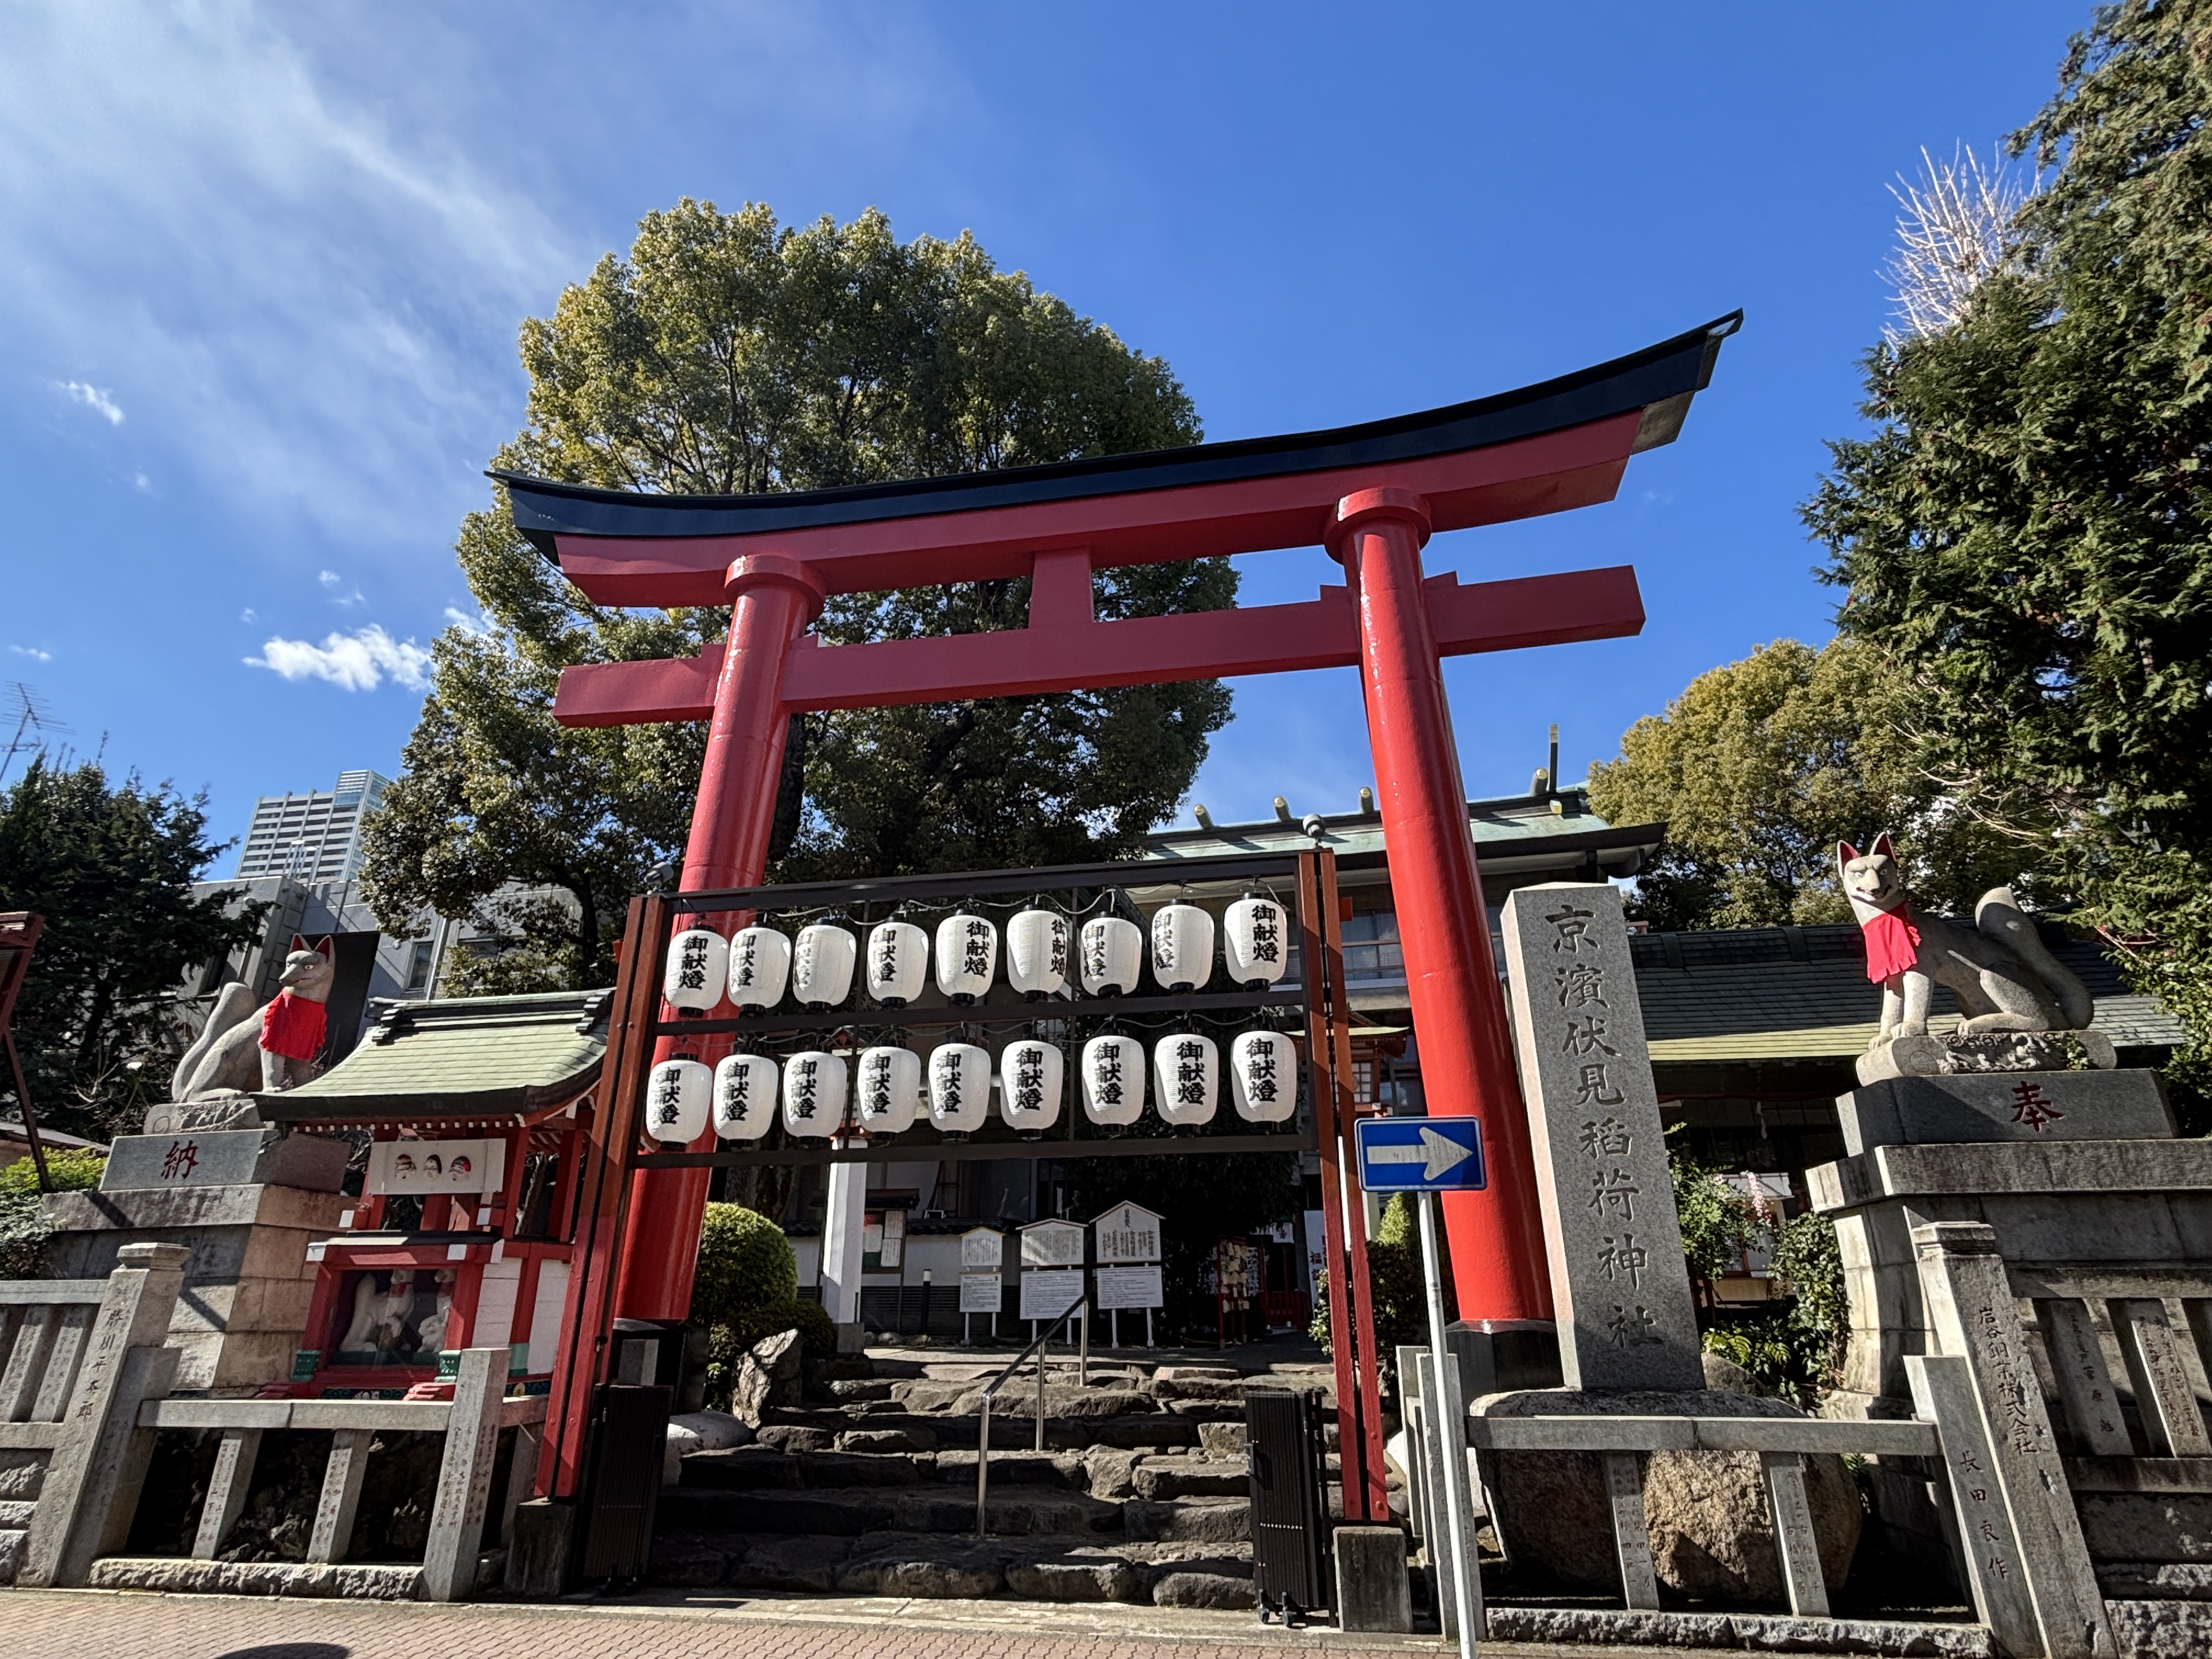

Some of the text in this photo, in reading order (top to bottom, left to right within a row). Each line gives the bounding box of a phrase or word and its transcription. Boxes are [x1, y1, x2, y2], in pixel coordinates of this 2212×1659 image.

[679, 935, 709, 990] 御献燈
[964, 921, 989, 977] 御献燈
[1251, 904, 1279, 963] 御献燈
[721, 1062, 750, 1121] 御献燈
[791, 1059, 817, 1119] 御献燈
[864, 1053, 891, 1114] 御献燈
[935, 1051, 962, 1114] 御献燈
[1014, 1047, 1043, 1111] 御献燈
[1093, 1042, 1124, 1105] 御献燈
[1176, 1041, 1207, 1105] 御献燈
[1245, 1038, 1279, 1103] 御献燈
[2011, 1081, 2065, 1133] 奉
[160, 1139, 199, 1180] 納
[1959, 1449, 2009, 1581] 長田良作
